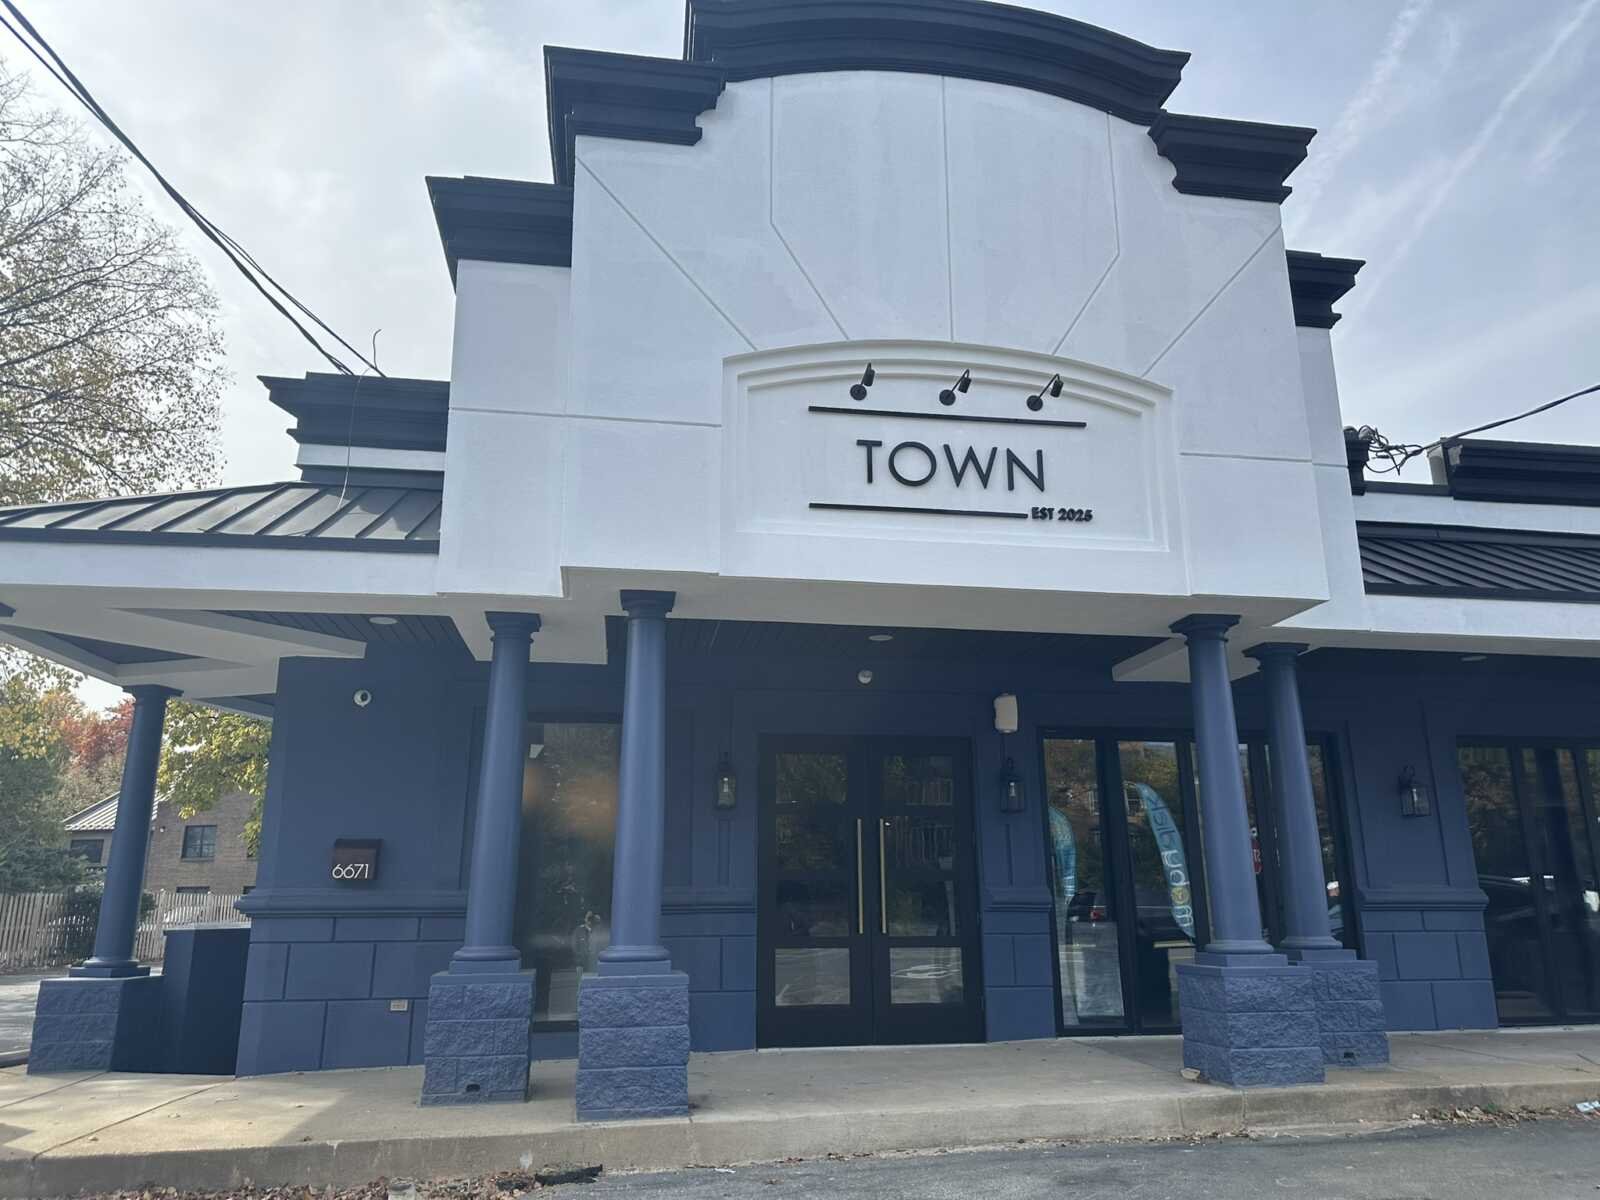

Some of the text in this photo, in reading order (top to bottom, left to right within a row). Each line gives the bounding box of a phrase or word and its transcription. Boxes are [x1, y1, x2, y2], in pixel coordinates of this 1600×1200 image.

[856, 439, 1045, 492] TOWN
[1031, 506, 1093, 523] EST 2025
[331, 863, 369, 879] 6671
